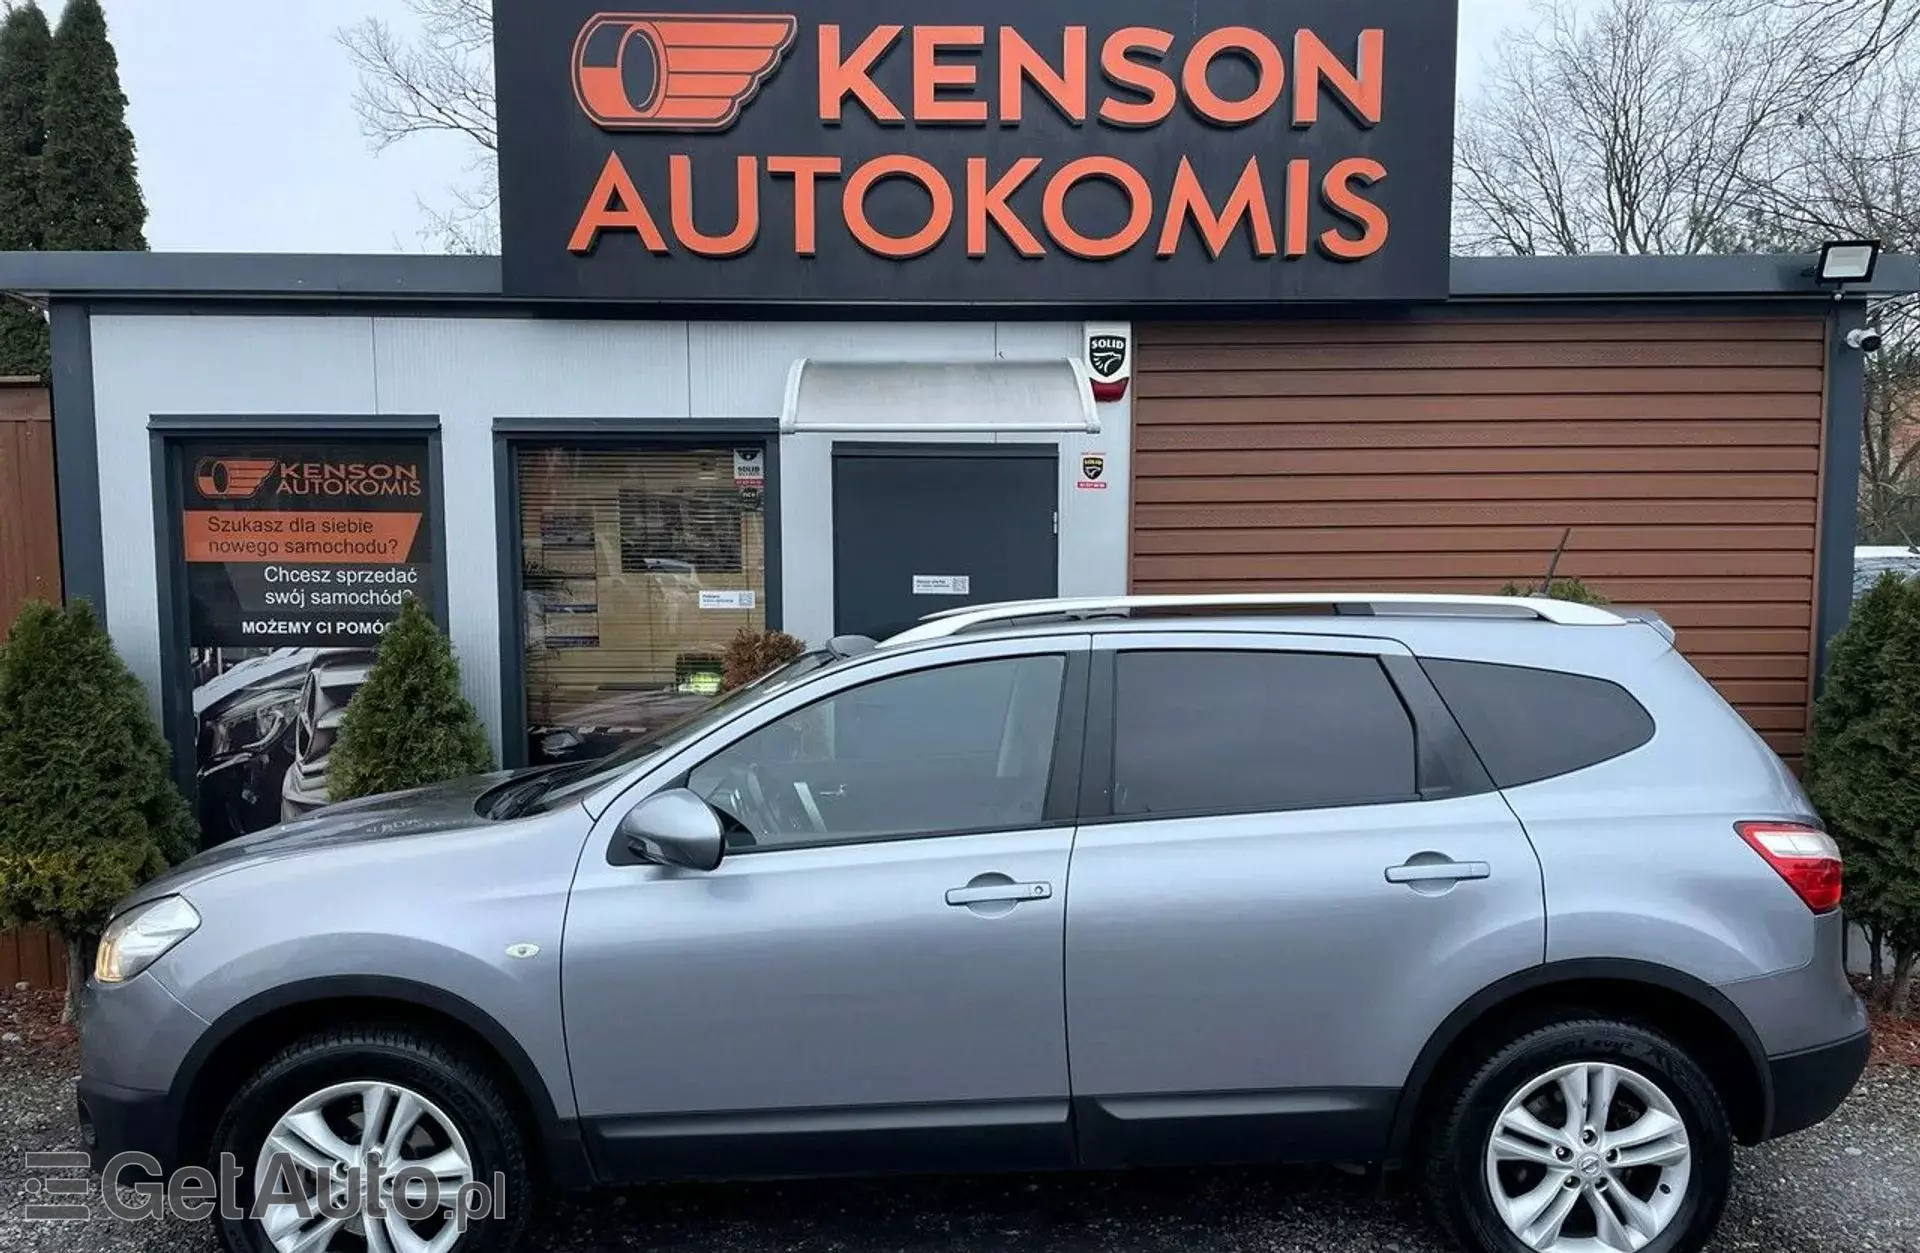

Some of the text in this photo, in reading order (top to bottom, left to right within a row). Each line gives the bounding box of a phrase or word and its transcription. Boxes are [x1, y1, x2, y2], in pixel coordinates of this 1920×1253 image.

[817, 25, 1385, 126] KENSON
[567, 150, 1390, 260] AUTOKOMIS
[1091, 338, 1124, 349] SOLID
[279, 463, 418, 479] KENSON
[275, 479, 421, 496] AUTOKOMIS
[207, 516, 374, 534] Szukasz dla siebie
[208, 538, 398, 557] nowego samochodu?
[264, 566, 418, 586] Chcesz sprzedać
[265, 588, 305, 608] swój
[241, 618, 312, 635] MOŻEMY
[316, 621, 332, 635] CI
